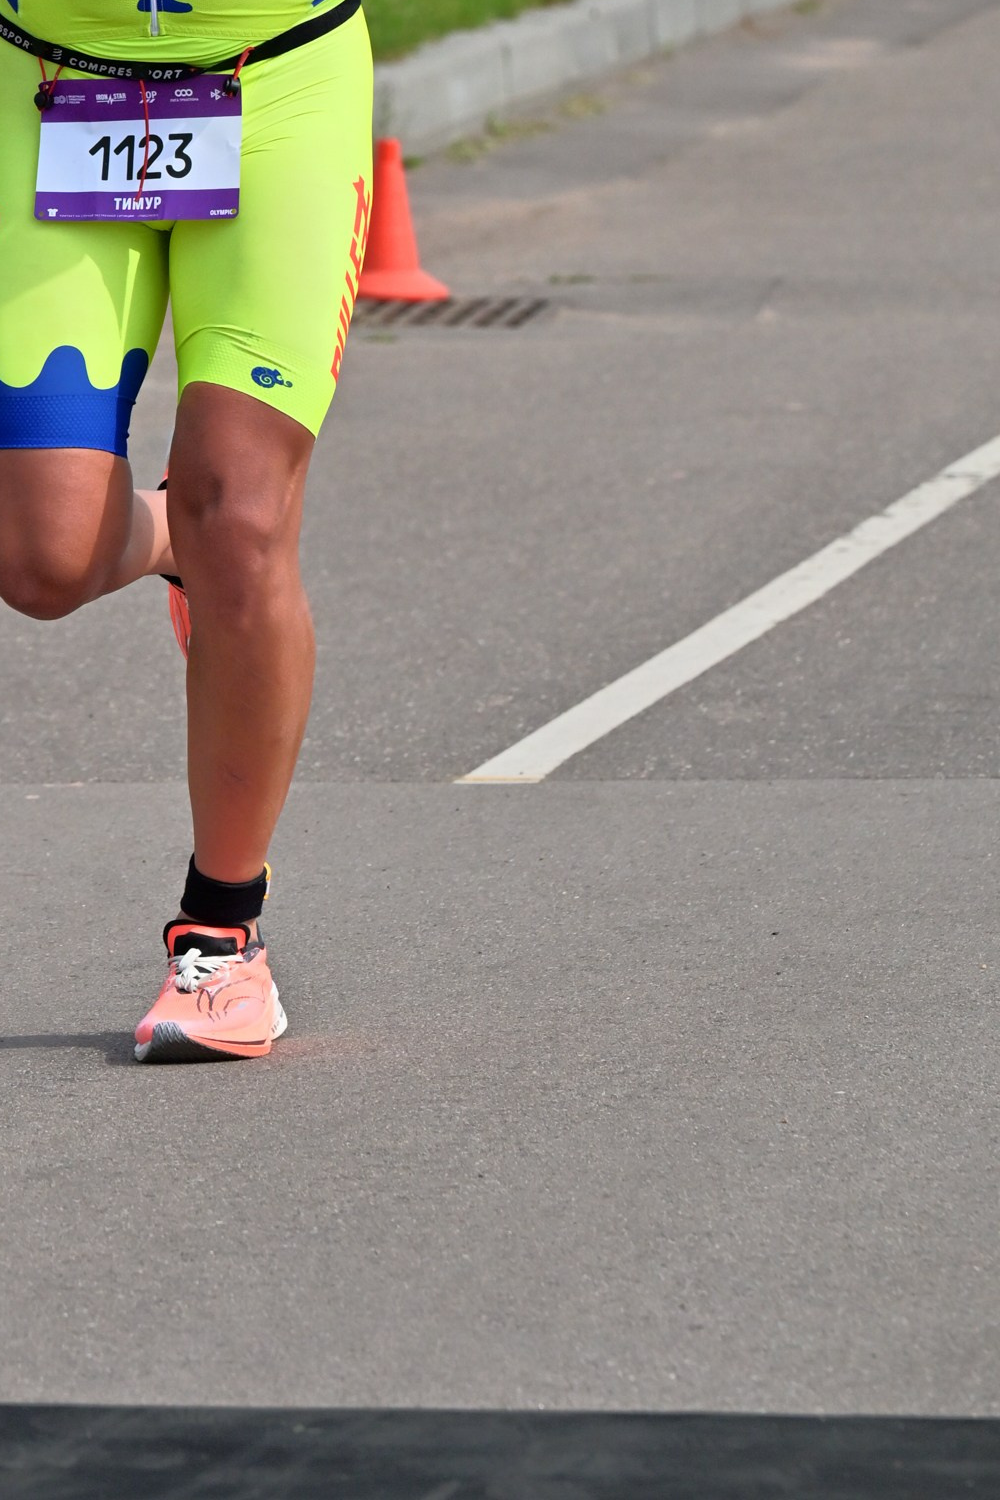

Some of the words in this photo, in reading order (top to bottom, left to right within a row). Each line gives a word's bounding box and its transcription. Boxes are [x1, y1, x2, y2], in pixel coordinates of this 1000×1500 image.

[69, 57, 183, 80] COMPRESORT
[113, 92, 127, 100] STAR
[88, 133, 193, 181] 1123
[114, 196, 162, 211] ТИМУР
